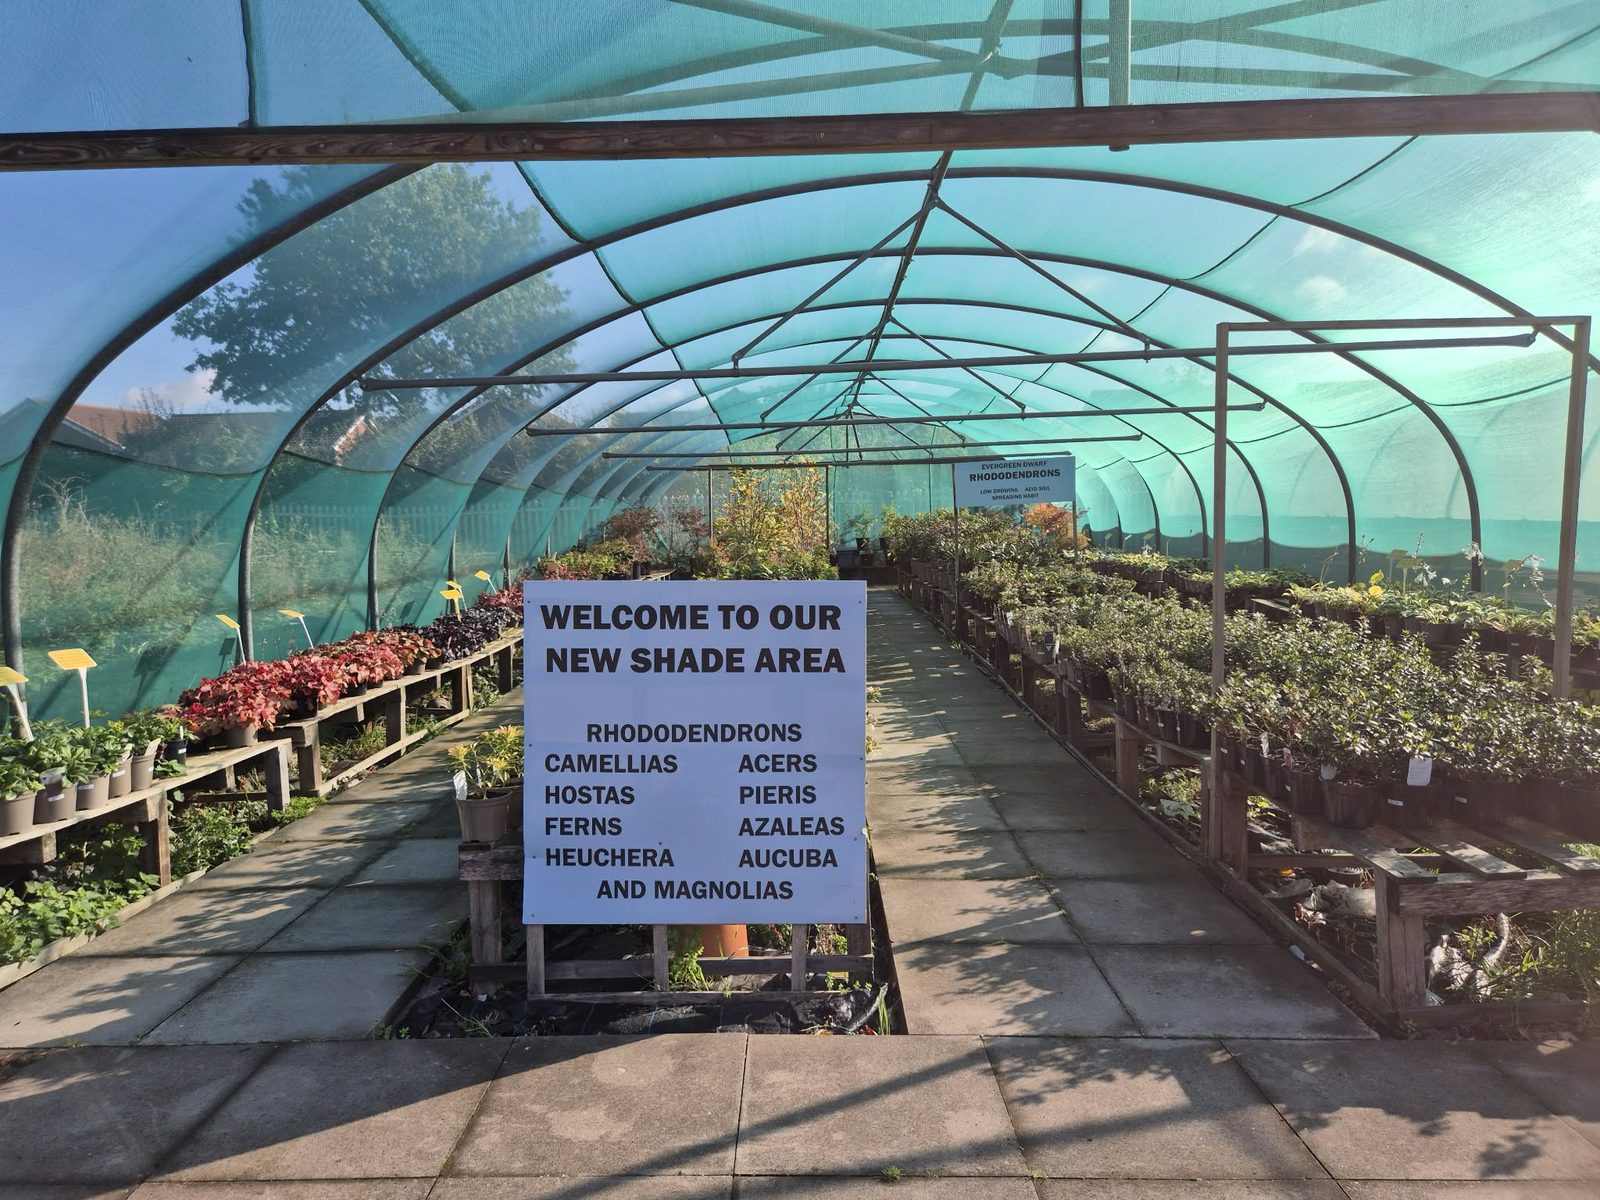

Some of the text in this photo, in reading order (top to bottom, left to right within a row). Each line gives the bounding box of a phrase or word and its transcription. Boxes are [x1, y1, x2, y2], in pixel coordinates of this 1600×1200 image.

[969, 468, 1061, 482] RHODODENDRONS
[982, 460, 1048, 470] EVERGREEN DWARF
[540, 604, 842, 631] WELCOME TO OUR
[546, 647, 846, 674] NEW SHADE AREA
[586, 723, 803, 743] RHODODENDRONS
[544, 753, 679, 774] CAMELLIAS
[738, 753, 818, 774] ACERS
[544, 785, 636, 805] HOSTAS
[739, 784, 817, 805] PIERIS
[545, 816, 623, 836] FERNS
[738, 816, 845, 837] AZALEAS
[545, 848, 675, 868] HEUCHERA
[738, 848, 838, 868] AUCUBA
[596, 880, 794, 901] AND MAGNOLIAS
